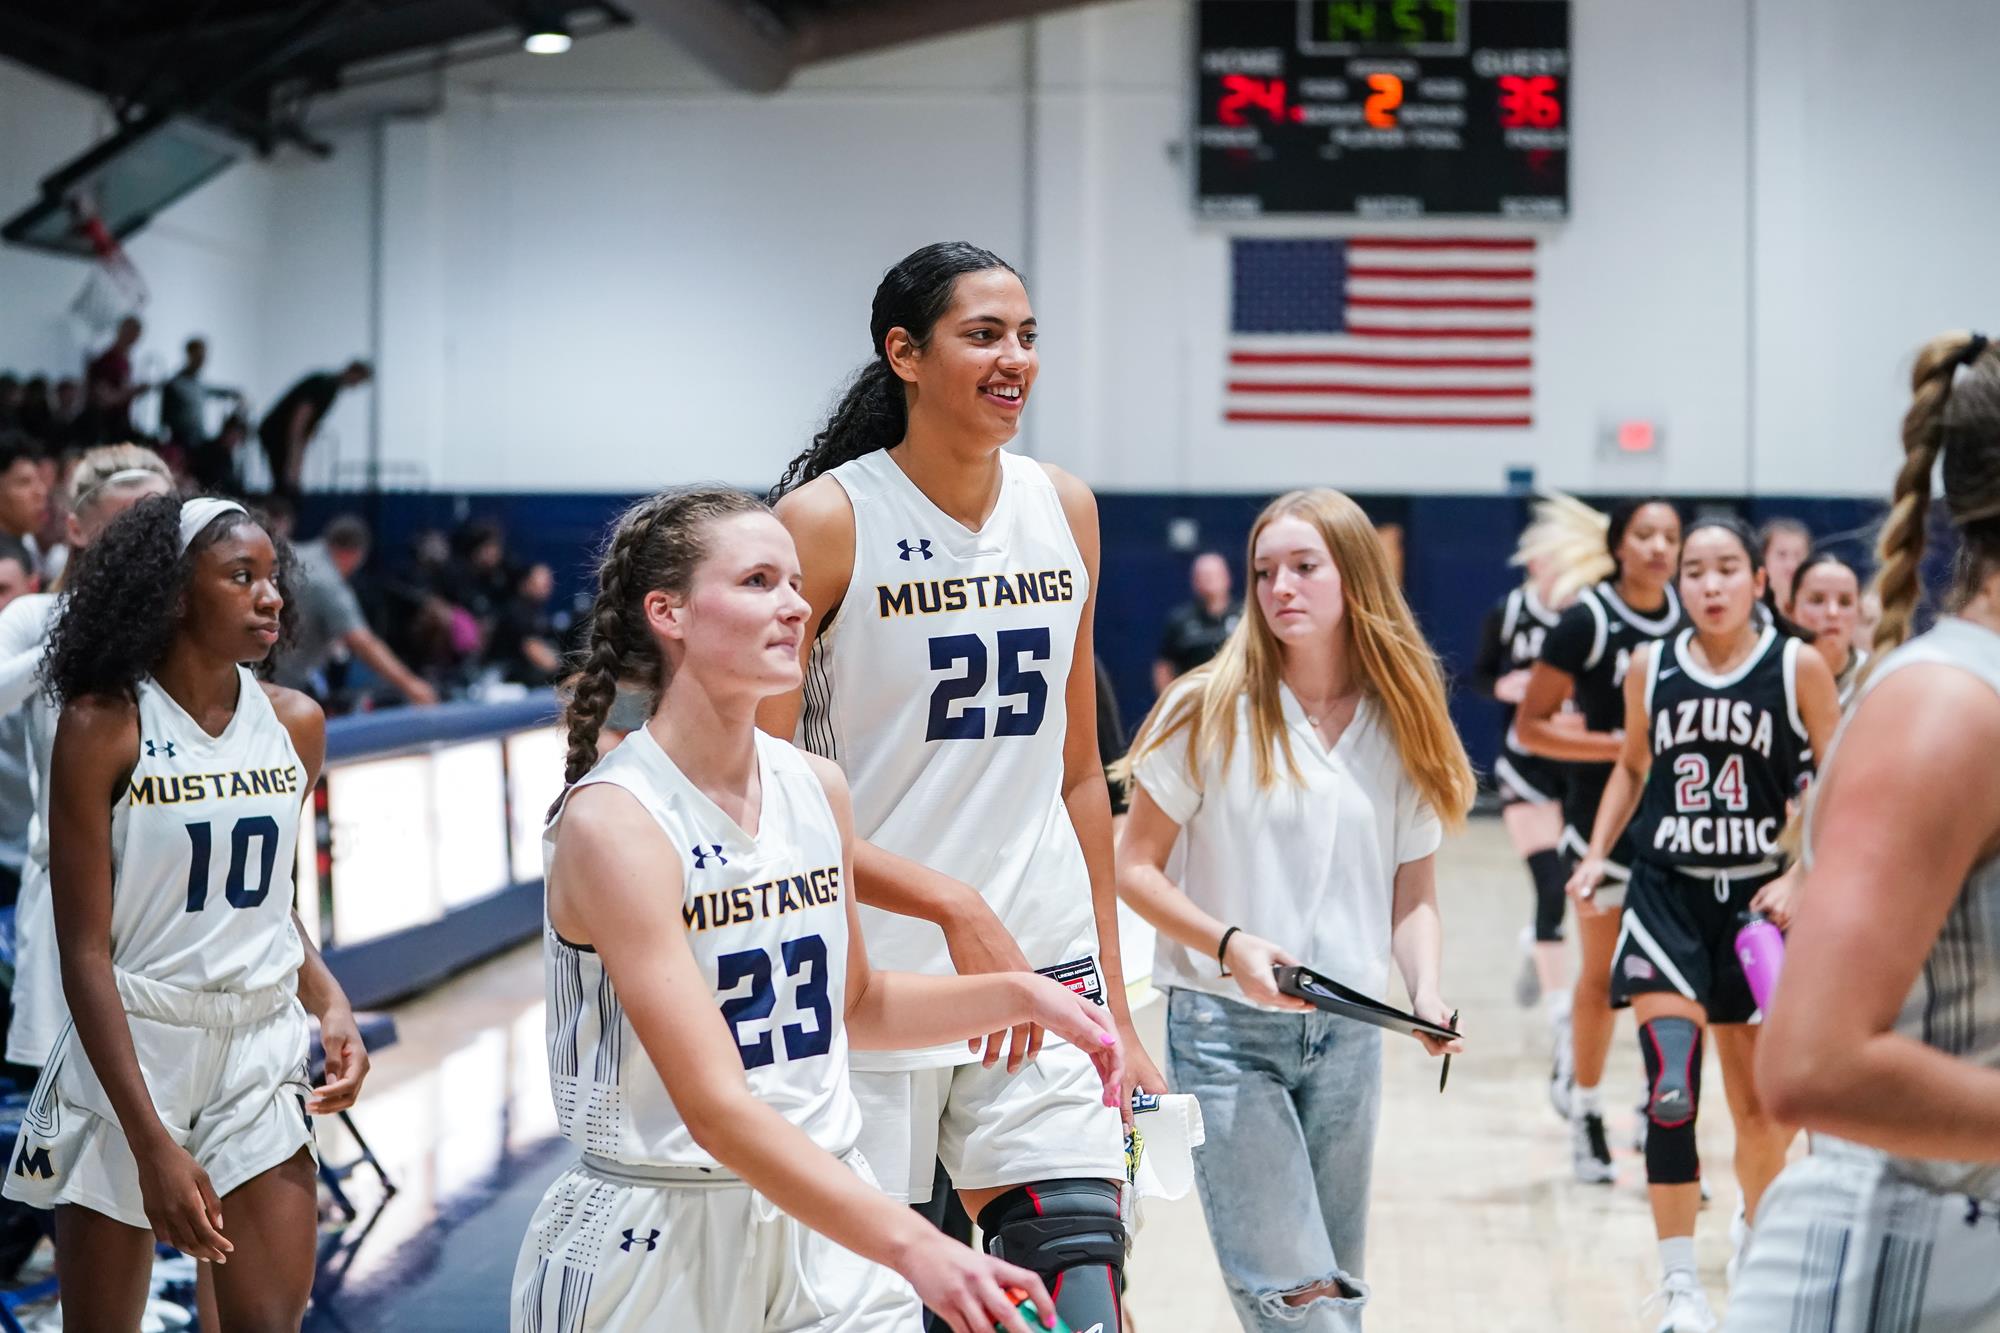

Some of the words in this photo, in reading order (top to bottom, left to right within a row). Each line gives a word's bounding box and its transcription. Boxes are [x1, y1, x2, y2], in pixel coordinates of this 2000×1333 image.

[1364, 72, 1403, 129] 2
[876, 569, 1073, 619] MUSTANGS
[925, 627, 1050, 742] 25
[1654, 697, 1774, 759] AZUSA
[130, 765, 297, 807] MUSTANGS
[1673, 753, 1748, 813] 24
[185, 815, 279, 913] 10
[1653, 815, 1778, 855] PACIFIC
[682, 866, 839, 932] MUSTANGS
[717, 934, 832, 1070] 23
